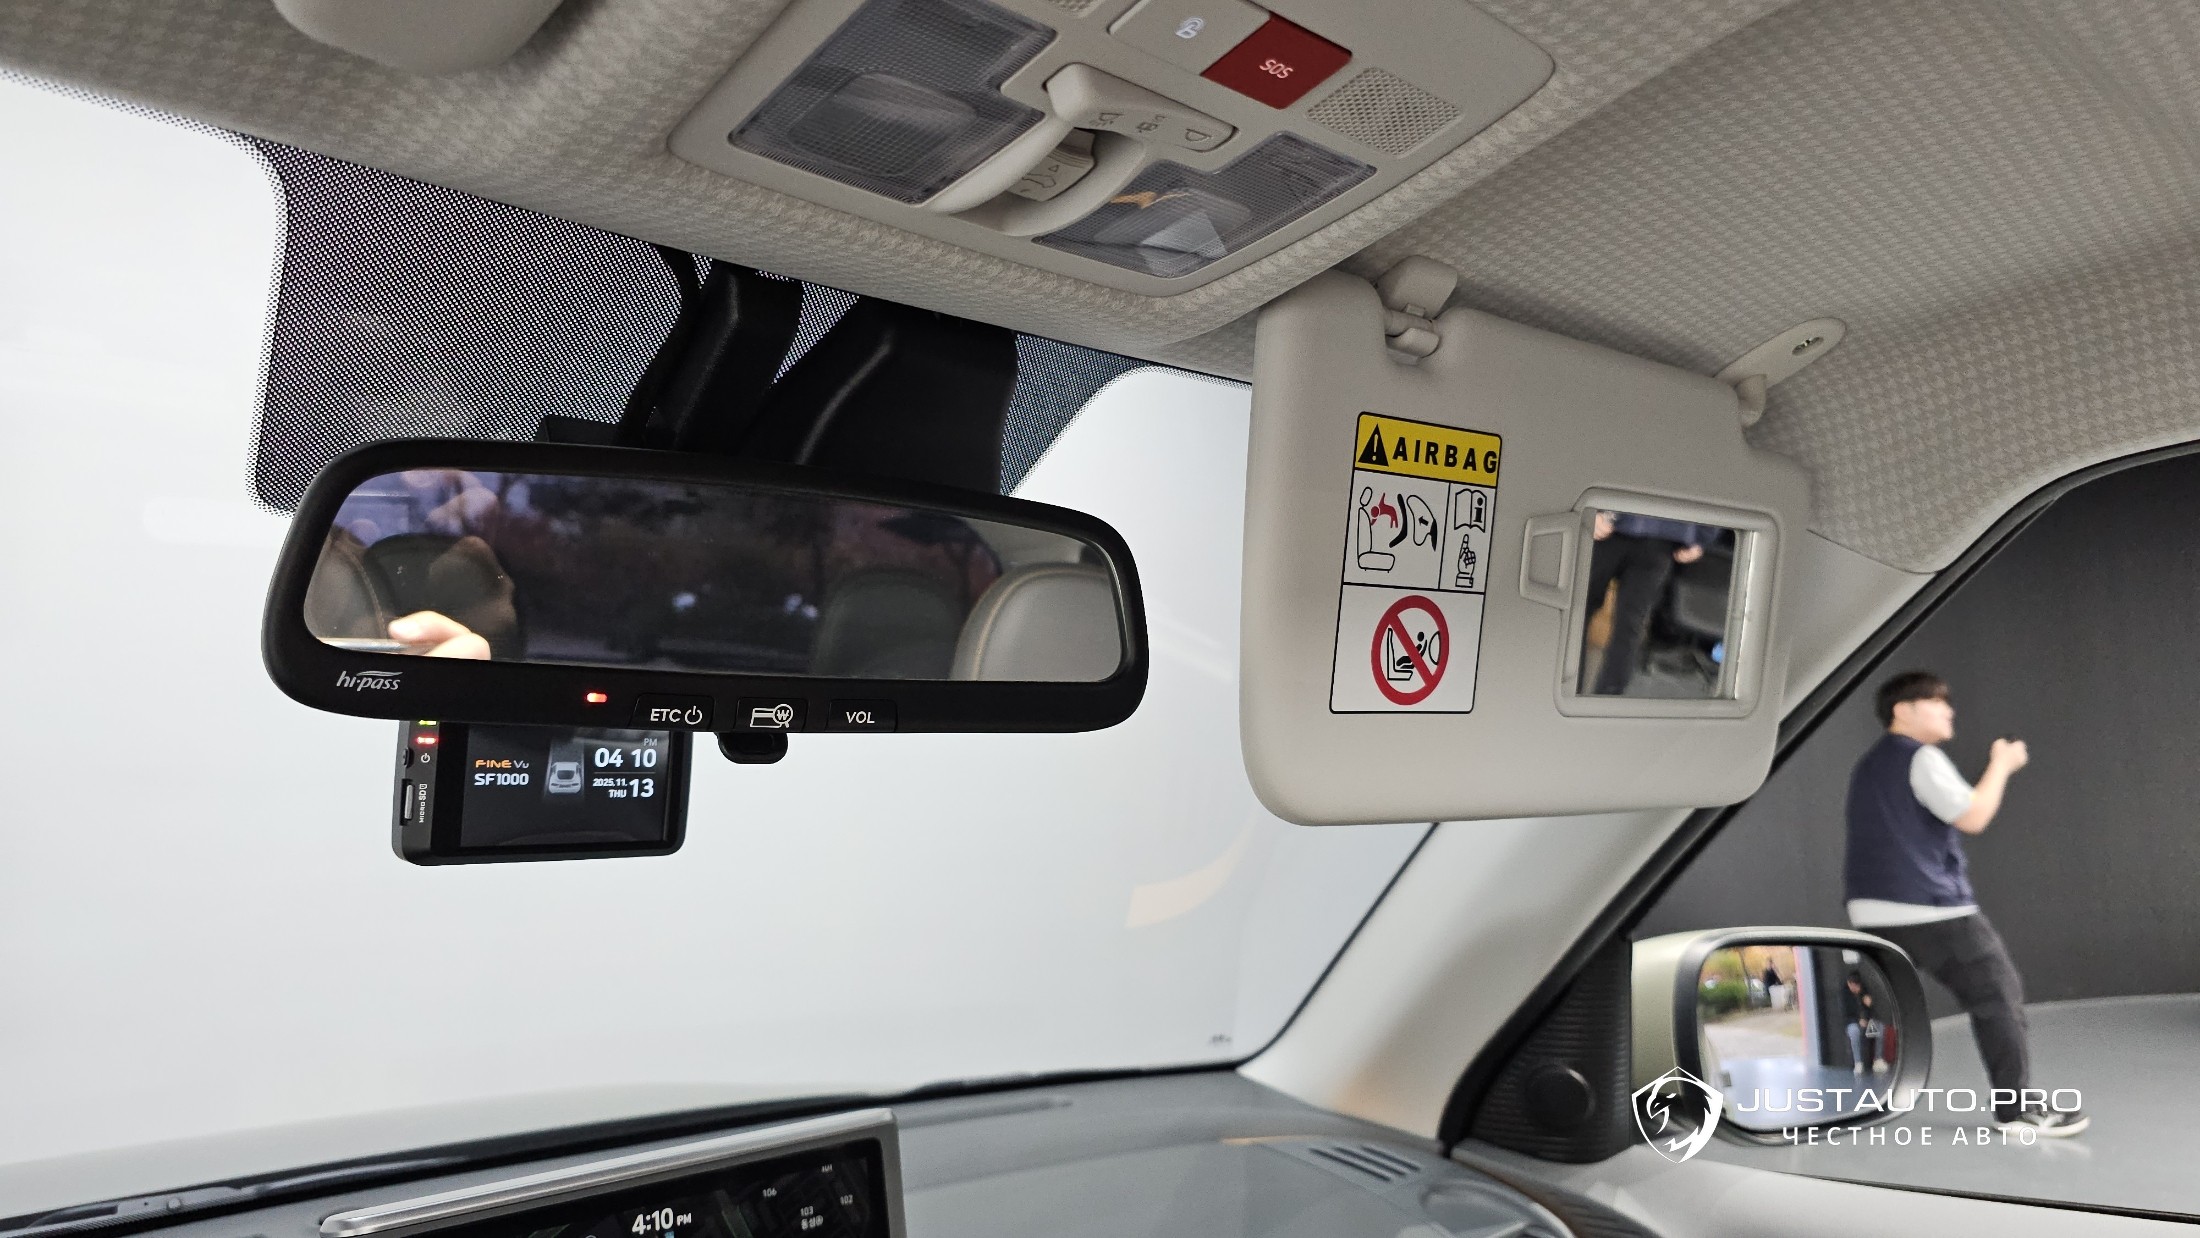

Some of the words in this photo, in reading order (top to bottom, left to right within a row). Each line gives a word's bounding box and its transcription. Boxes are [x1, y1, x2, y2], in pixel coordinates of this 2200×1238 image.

[1259, 59, 1293, 79] SOS
[1392, 436, 1497, 474] AIRBAG
[650, 708, 682, 723] ETC
[845, 711, 875, 724] VOL
[643, 737, 658, 747] PM
[594, 747, 624, 768] 04
[630, 748, 657, 768] 10
[474, 772, 530, 786] SF1000
[608, 789, 627, 798] THU
[629, 778, 655, 798] 13
[631, 1207, 674, 1235] 4:10
[676, 1212, 692, 1227] PM
